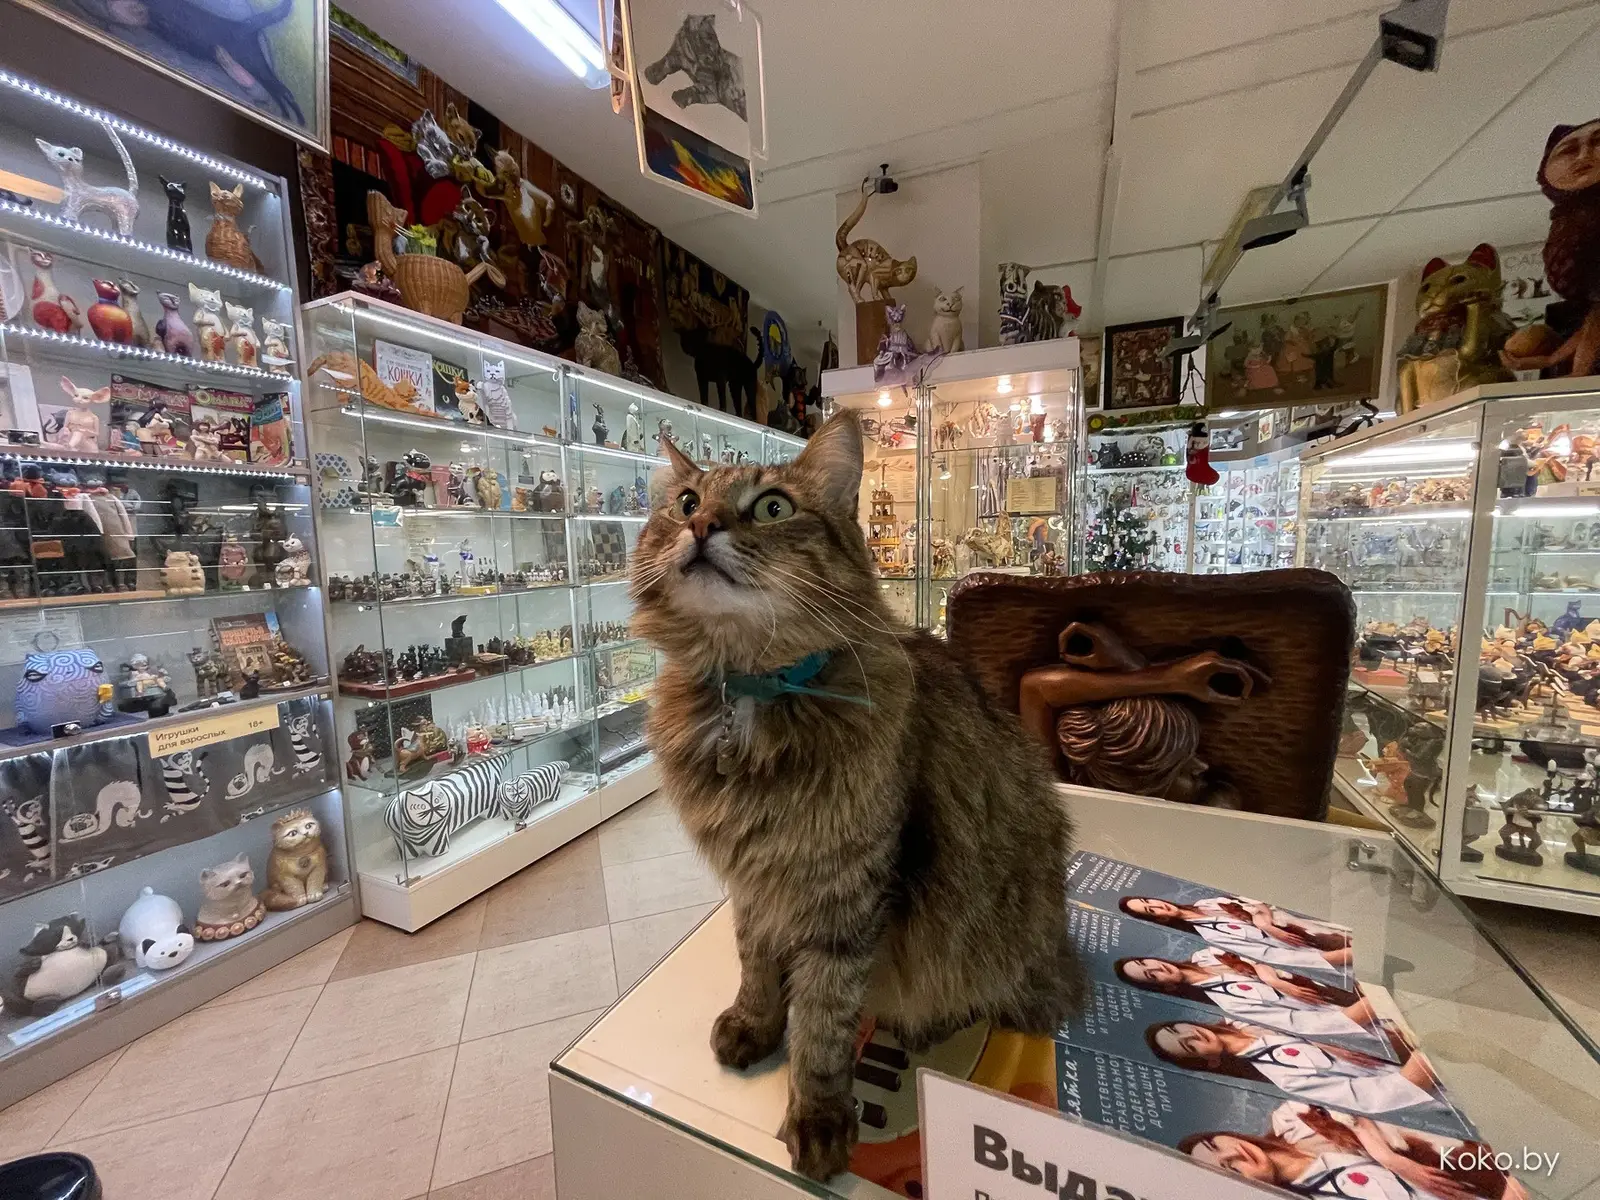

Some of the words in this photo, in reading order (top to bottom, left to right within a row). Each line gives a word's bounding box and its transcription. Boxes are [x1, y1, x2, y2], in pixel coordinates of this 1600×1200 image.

[387, 364, 423, 388] КОШКИ
[155, 727, 199, 742] Игрушки
[248, 720, 263, 729] 18+
[157, 743, 178, 752] для
[180, 729, 226, 745] взрослых
[1087, 913, 1099, 954] СОДЕРЖАНИЮ
[1099, 915, 1110, 954] ДОМАШНЕГО
[1111, 918, 1121, 947] ПИТОМЦА
[1096, 1052, 1114, 1125] ЕТСТВЕННО
[1110, 1055, 1131, 1132] ПРАВИЛЬНО
